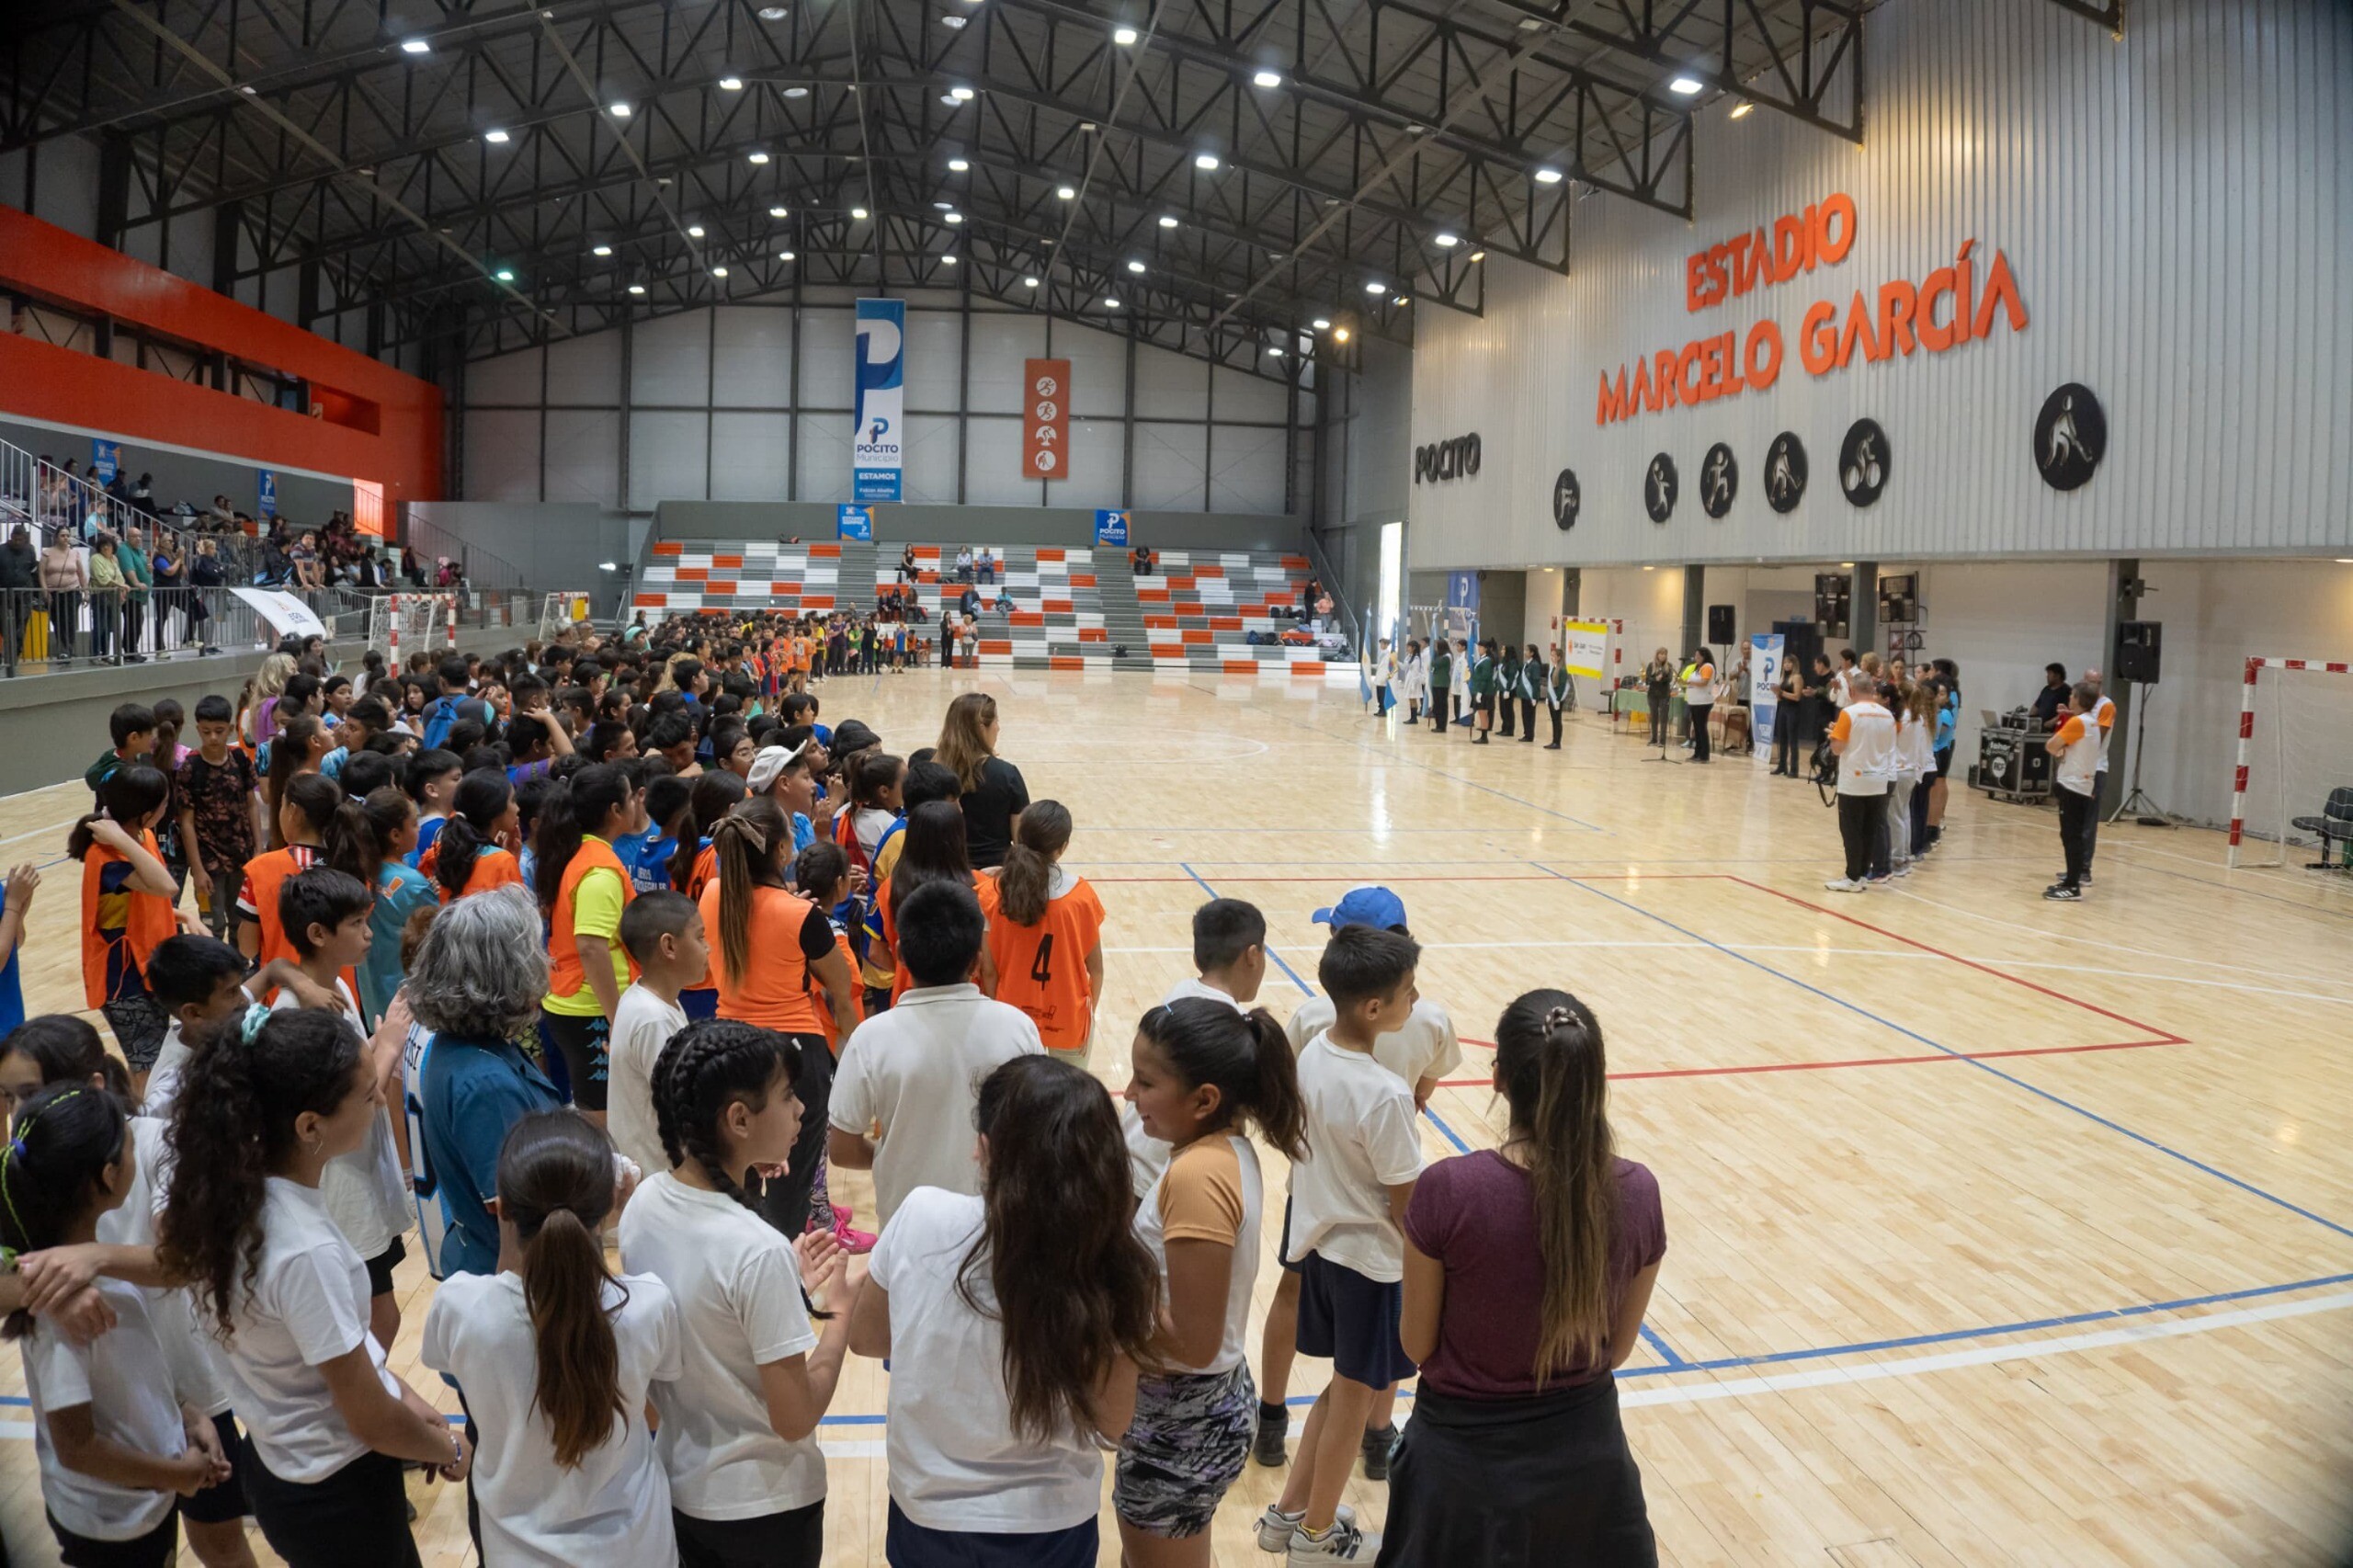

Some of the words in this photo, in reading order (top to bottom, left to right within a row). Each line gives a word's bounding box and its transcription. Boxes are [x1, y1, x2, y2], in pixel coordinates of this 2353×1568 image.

[1687, 193, 1857, 312] ESTADIO
[1597, 319, 1783, 426] MARCELO
[1801, 238, 2029, 375] GARCÍA
[857, 444, 899, 453] POCITO
[1415, 432, 1481, 484] POCITO
[1031, 933, 1053, 991] 4
